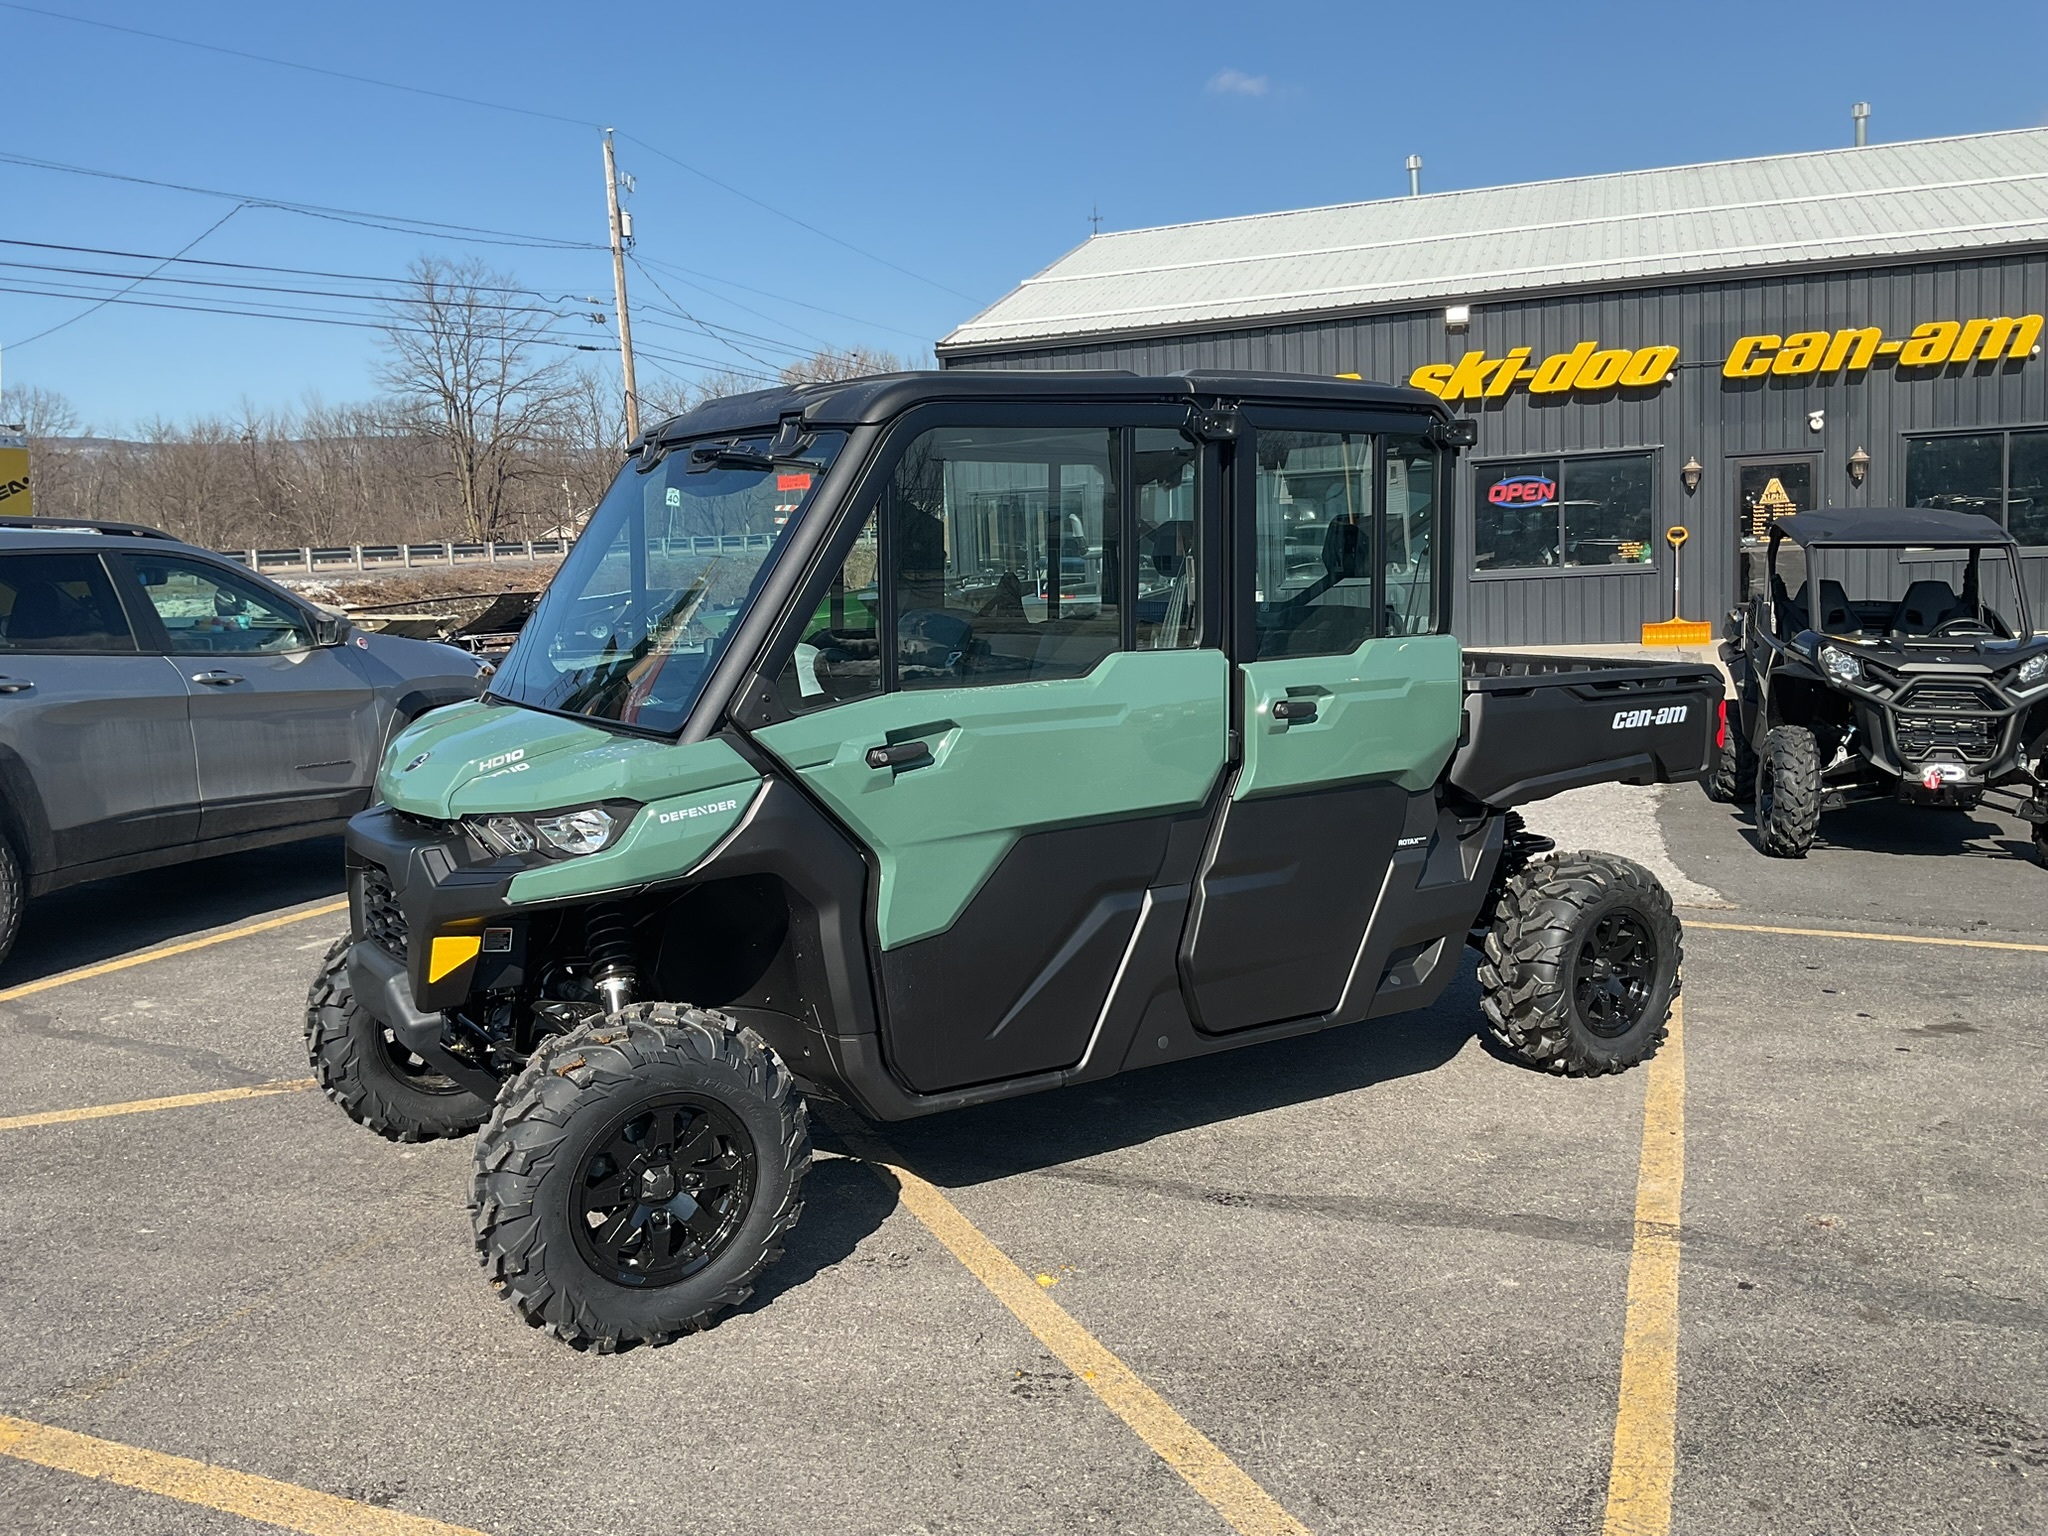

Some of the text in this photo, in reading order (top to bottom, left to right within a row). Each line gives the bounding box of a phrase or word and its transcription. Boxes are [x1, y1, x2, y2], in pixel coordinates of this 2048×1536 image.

[1722, 314, 2044, 378] can-am
[1408, 341, 1679, 400] ski-doo
[667, 494, 680, 504] 40
[1488, 482, 1556, 503] OPEN
[1761, 493, 1789, 502] ALPHA
[1612, 705, 1688, 730] can-am
[479, 748, 525, 772] HD10
[659, 799, 738, 824] DEFENDER
[1398, 837, 1419, 846] ROTAX
